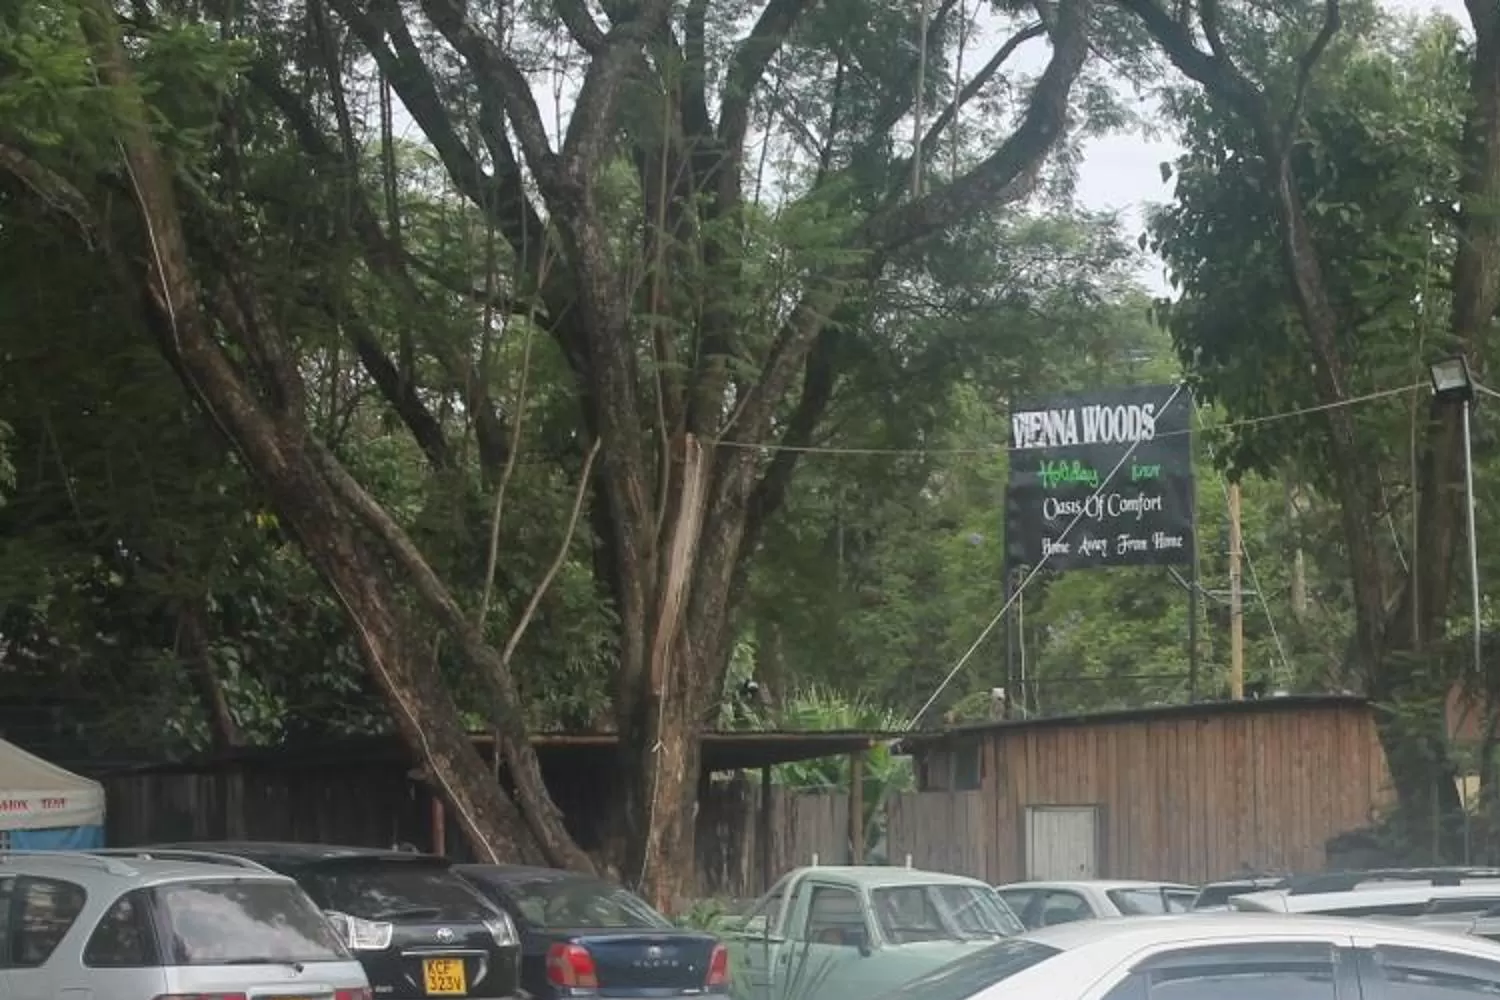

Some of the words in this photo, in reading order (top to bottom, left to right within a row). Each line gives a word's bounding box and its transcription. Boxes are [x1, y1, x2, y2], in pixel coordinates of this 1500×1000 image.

[1081, 403, 1156, 444] WOODS
[1043, 497, 1082, 521] Oasis
[1085, 493, 1106, 522] Of
[1107, 491, 1162, 521] Comfort
[1077, 534, 1108, 558] Away
[1117, 532, 1148, 555] From
[1152, 531, 1183, 549] Home
